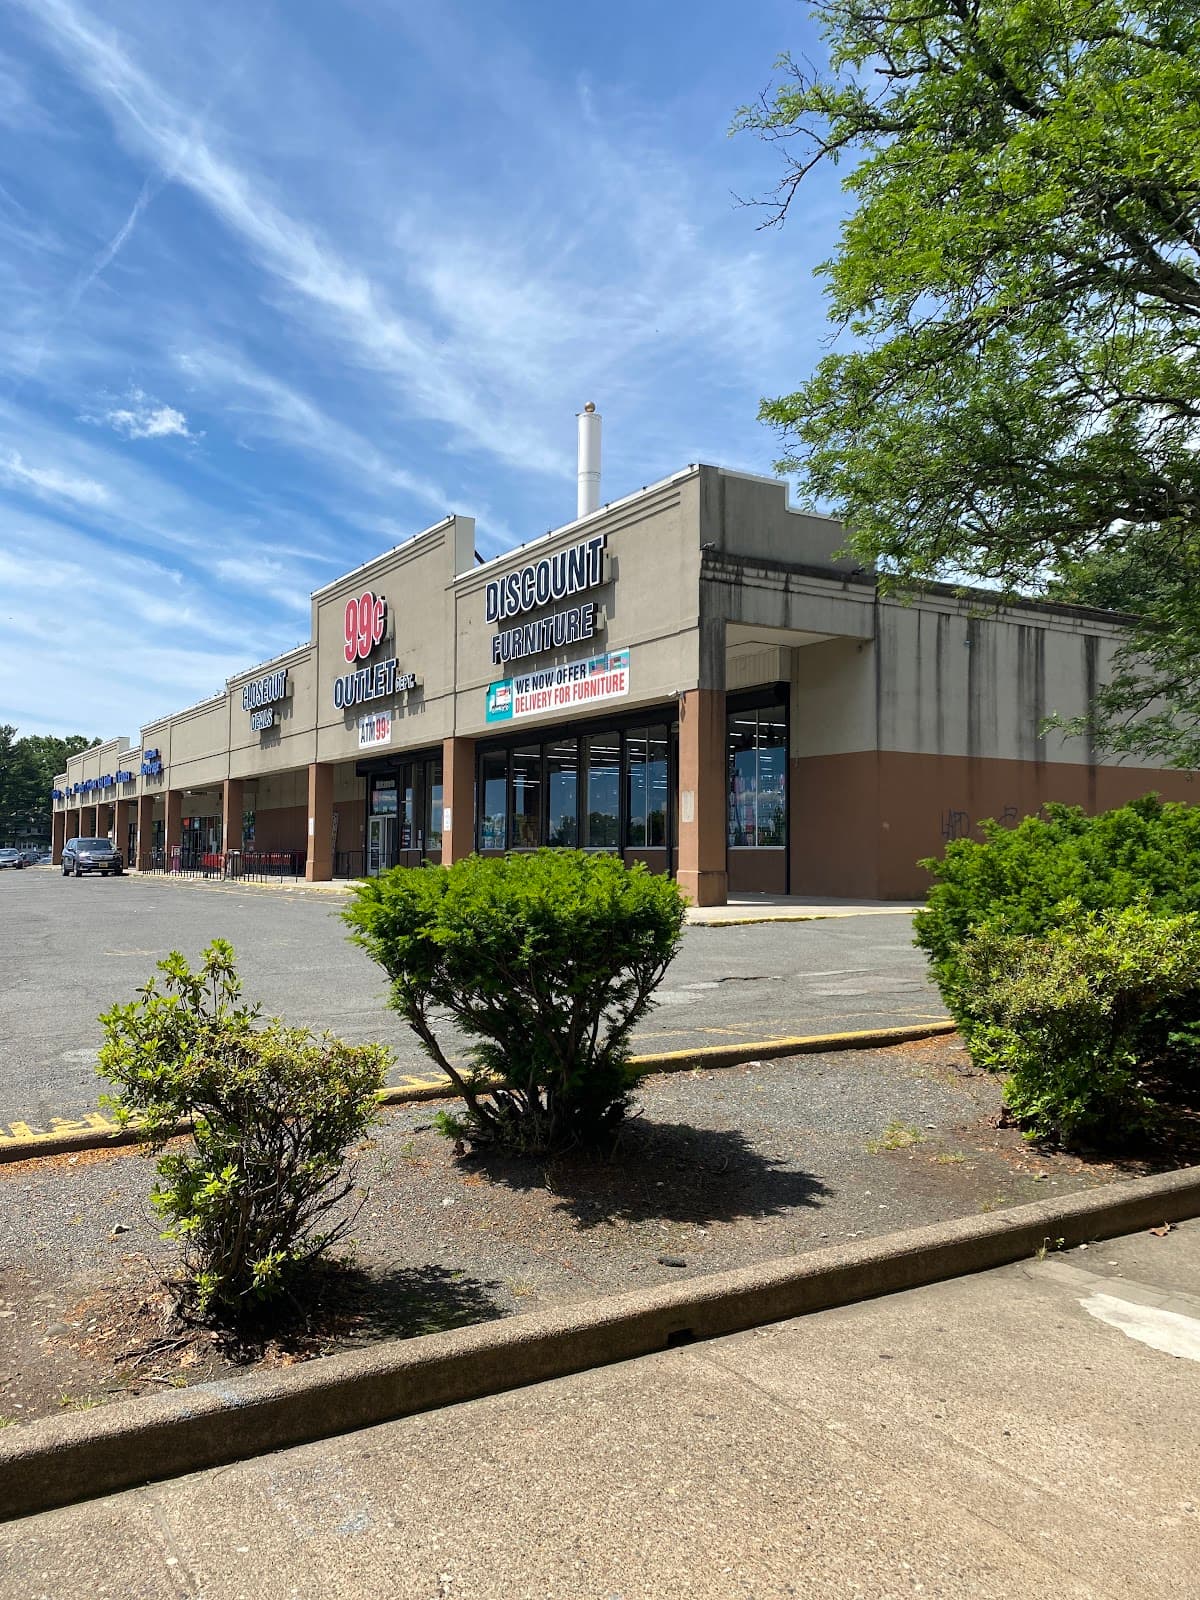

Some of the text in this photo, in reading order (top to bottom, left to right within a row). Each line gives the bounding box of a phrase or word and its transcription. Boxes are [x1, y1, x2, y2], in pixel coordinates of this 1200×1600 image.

[486, 535, 605, 624] DISCOUNT
[344, 591, 384, 663] 99¢
[491, 602, 594, 665] FURNITURE
[242, 669, 286, 712] CLOSEOUT
[333, 658, 396, 709] OUTLET
[515, 672, 625, 714] DELIVERY FOR FURNITURE
[516, 663, 587, 694] WE NOW OFFER
[251, 708, 273, 731] DEALS
[360, 721, 376, 743] ATM
